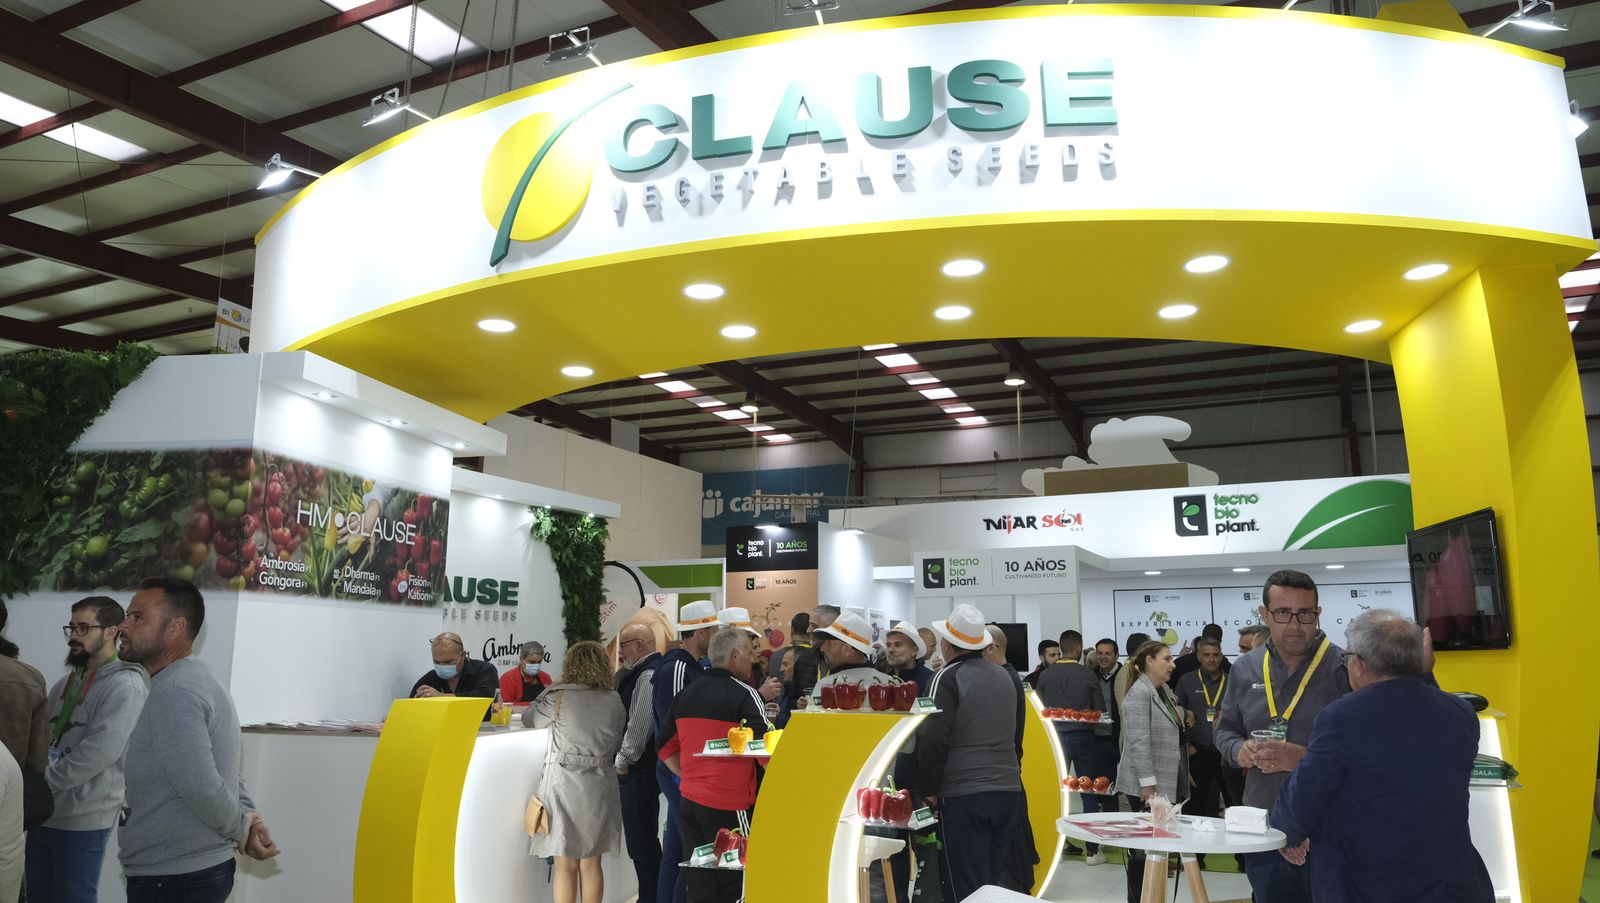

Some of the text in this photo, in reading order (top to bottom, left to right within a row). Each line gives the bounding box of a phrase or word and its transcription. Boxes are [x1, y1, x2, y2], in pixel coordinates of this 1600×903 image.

[604, 57, 1118, 174] CLAUSE
[610, 142, 1116, 213] VEGETABLE SEEDS
[1213, 493, 1259, 506] tecno
[1214, 506, 1240, 520] bio
[1215, 518, 1260, 536] plant.
[786, 540, 808, 549] AÑOS
[260, 555, 306, 573] Ambrosía
[950, 557, 980, 566] tecno
[1004, 557, 1067, 572] 10 AÑOS
[345, 565, 375, 581] Dharma
[950, 567, 966, 577] bio
[259, 571, 301, 590] Góngora
[343, 580, 376, 596] Mandala
[950, 576, 980, 588] plant.
[1121, 620, 1207, 628] EXPERIENCIA
